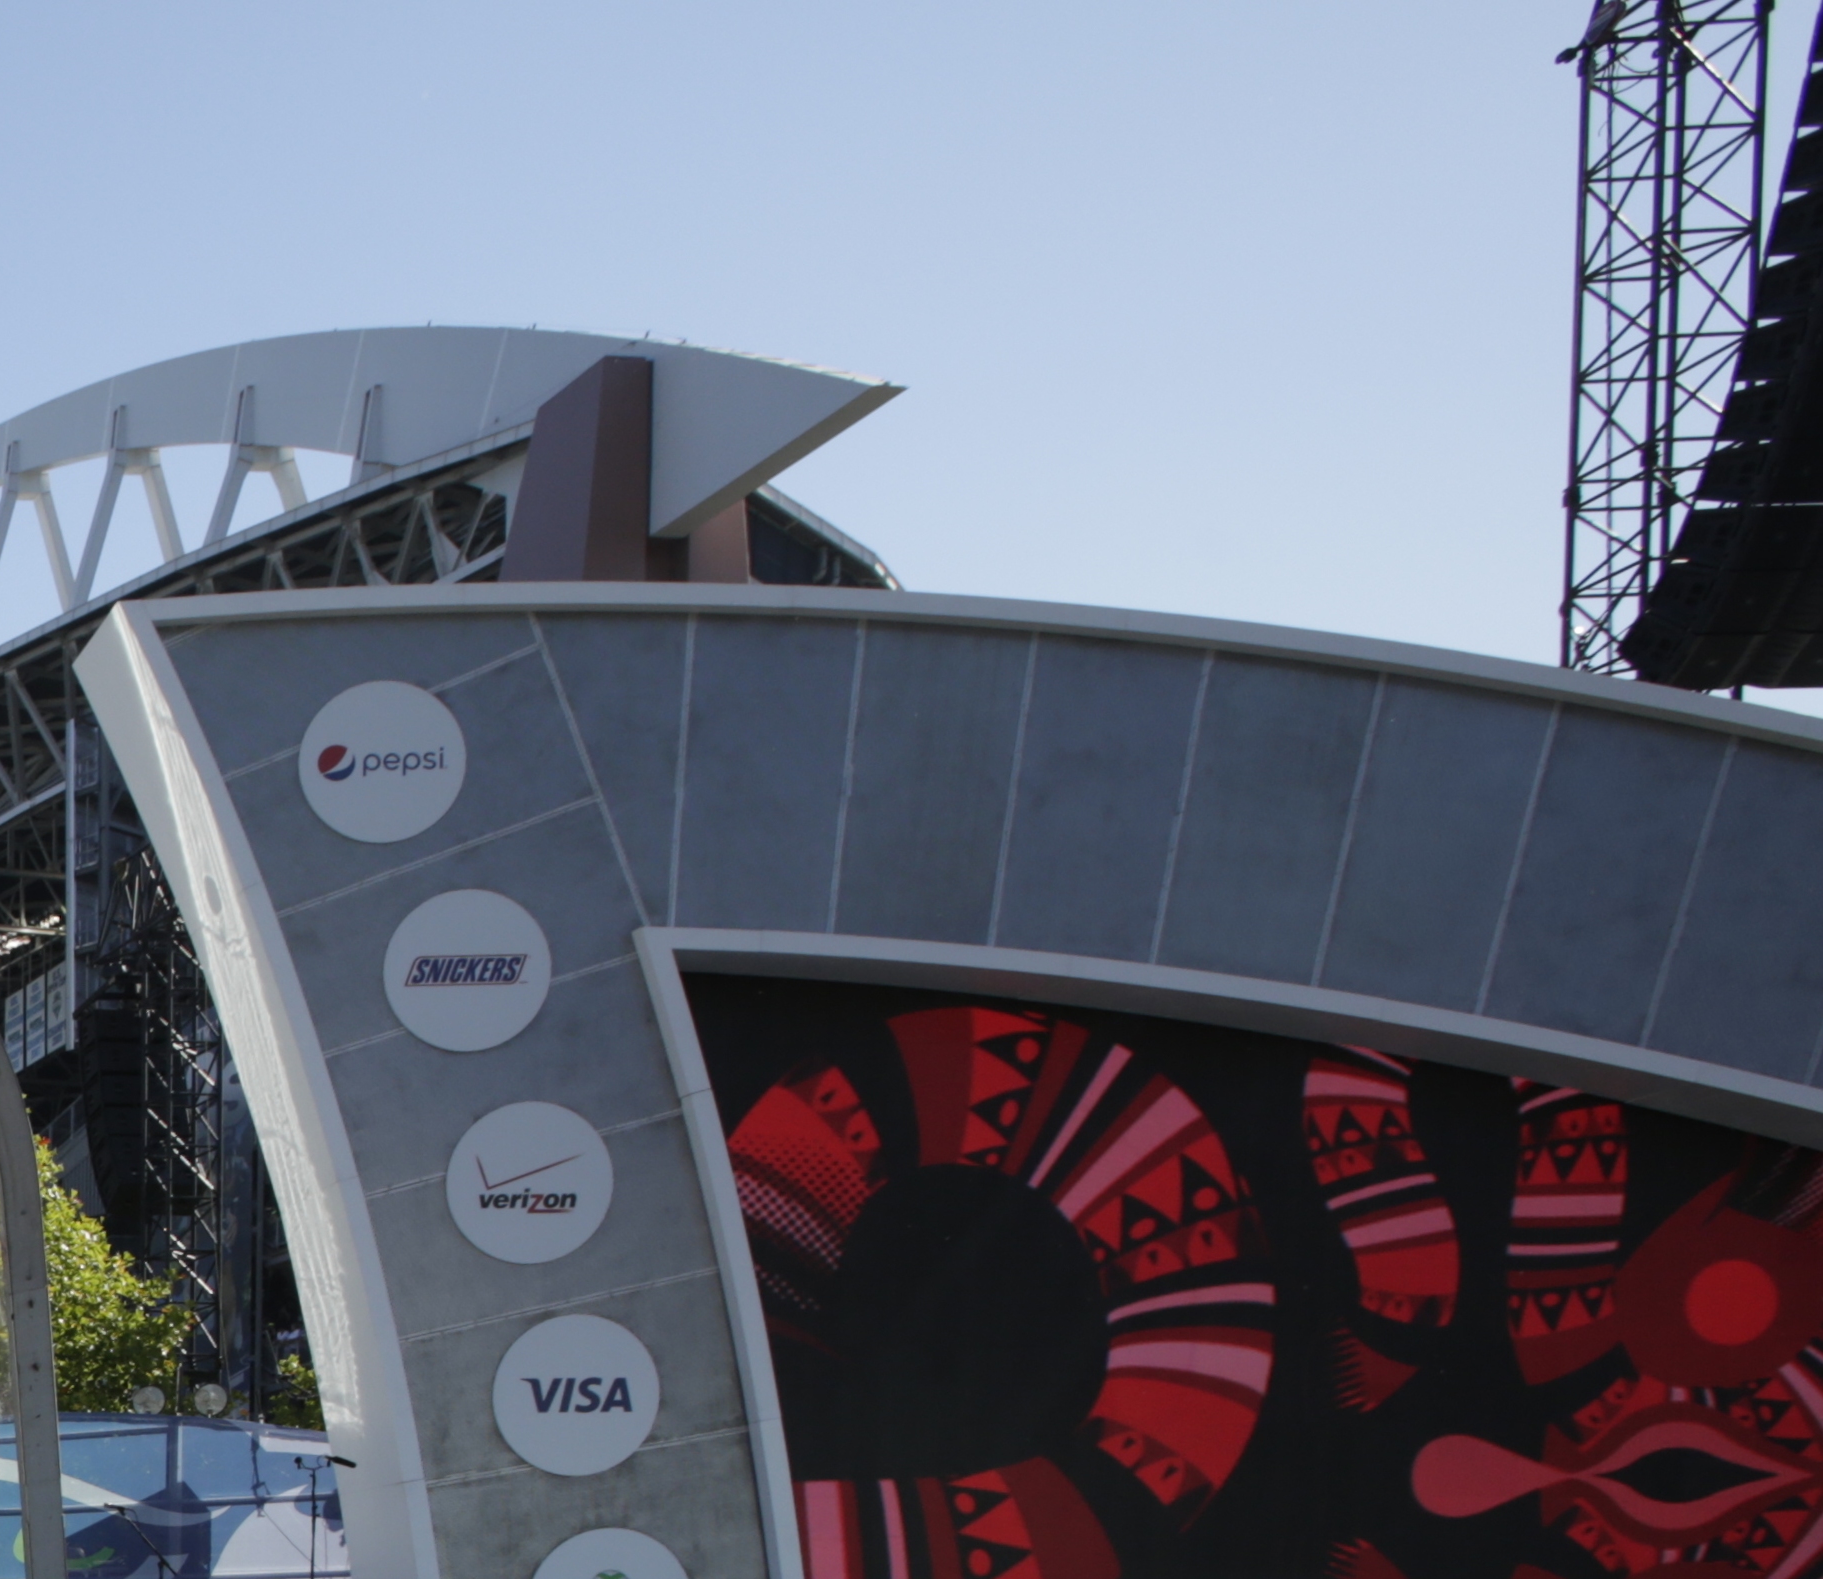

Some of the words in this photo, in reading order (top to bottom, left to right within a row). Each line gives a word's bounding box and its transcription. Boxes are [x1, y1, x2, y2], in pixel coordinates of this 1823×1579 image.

[362, 746, 446, 777] pepsi
[411, 956, 523, 984] SNICKERS
[478, 1189, 578, 1214] verizon
[520, 1377, 633, 1413] VISA
